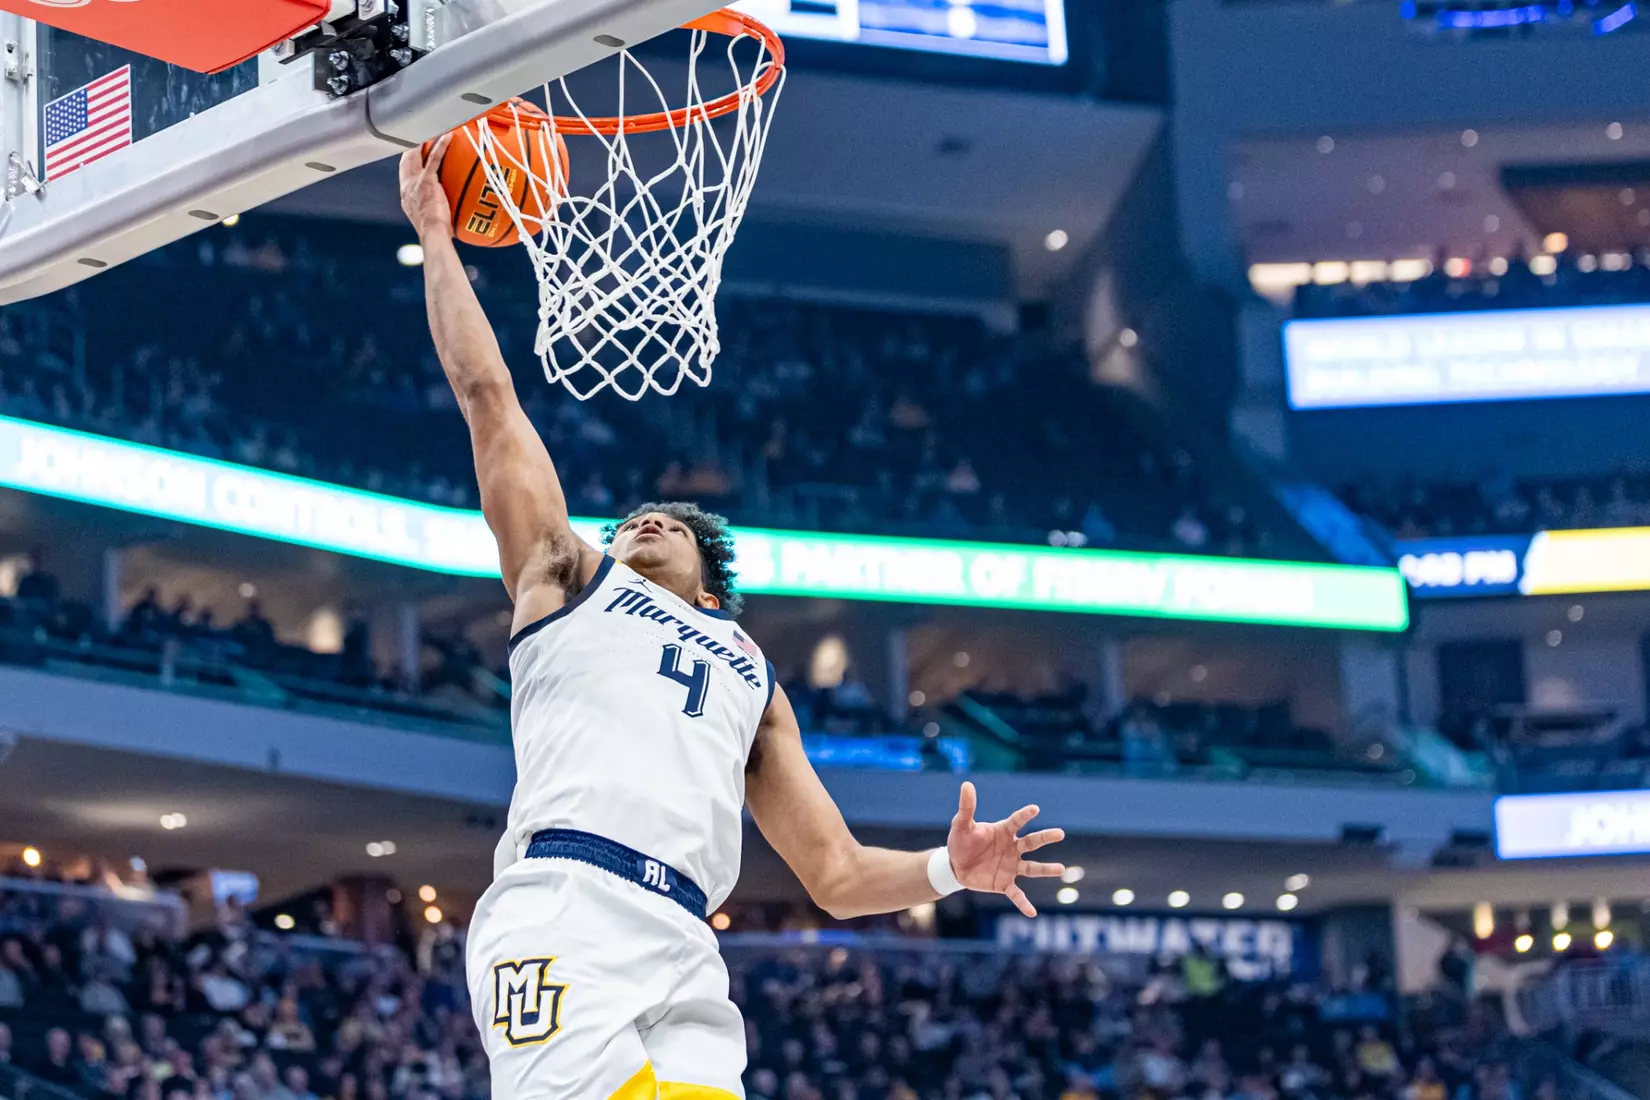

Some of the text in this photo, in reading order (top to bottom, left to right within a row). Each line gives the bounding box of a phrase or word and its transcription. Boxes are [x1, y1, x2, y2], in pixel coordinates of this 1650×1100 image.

[970, 554, 1027, 597] OF
[604, 587, 761, 690] Marquette
[656, 643, 710, 718] 4
[492, 955, 570, 1049] MU
